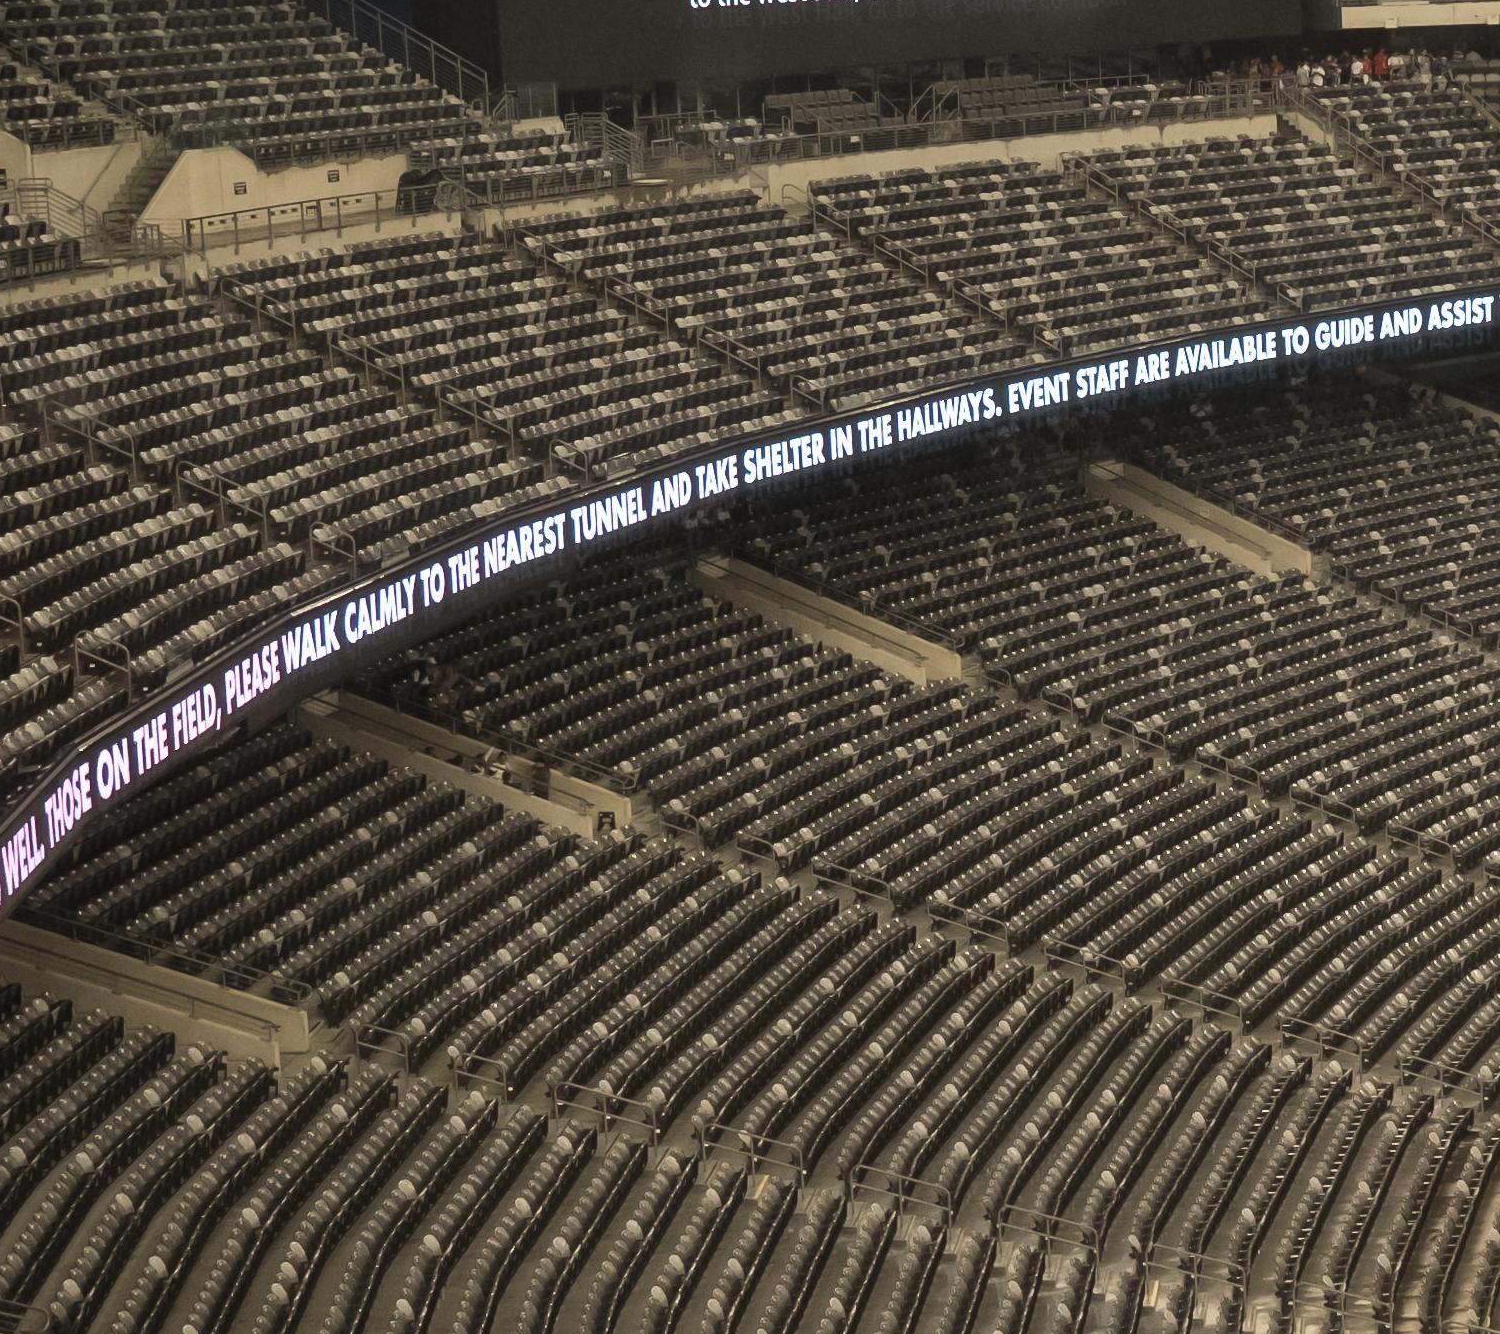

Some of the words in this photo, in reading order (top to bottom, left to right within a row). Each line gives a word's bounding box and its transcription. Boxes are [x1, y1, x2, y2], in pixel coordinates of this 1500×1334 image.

[45, 763, 92, 848] THOSE
[97, 738, 130, 799] ON
[133, 713, 168, 775] THE
[172, 684, 222, 750] FIELD,
[225, 641, 280, 714] PLEASE
[282, 610, 340, 674] WALK
[344, 573, 416, 643] CALMLY
[419, 563, 445, 604] TO
[448, 546, 480, 593] THE
[483, 513, 565, 578] NEAREST
[571, 487, 647, 543] TUNNEL
[651, 472, 691, 517] AND
[696, 455, 738, 499] TAKE
[744, 433, 825, 483] SHELTER
[830, 425, 853, 460] IN
[857, 414, 892, 452] THE
[897, 388, 1002, 441] HALLWAYS.
[1008, 372, 1070, 413] EVENT
[1076, 360, 1128, 398] STAFF
[1135, 351, 1170, 385] ARE
[1175, 332, 1276, 376] AVAILABLE
[1282, 326, 1309, 355] TO
[1315, 315, 1374, 350] GUIDE
[1380, 308, 1422, 339] AND
[1428, 296, 1494, 330] ASSIST
